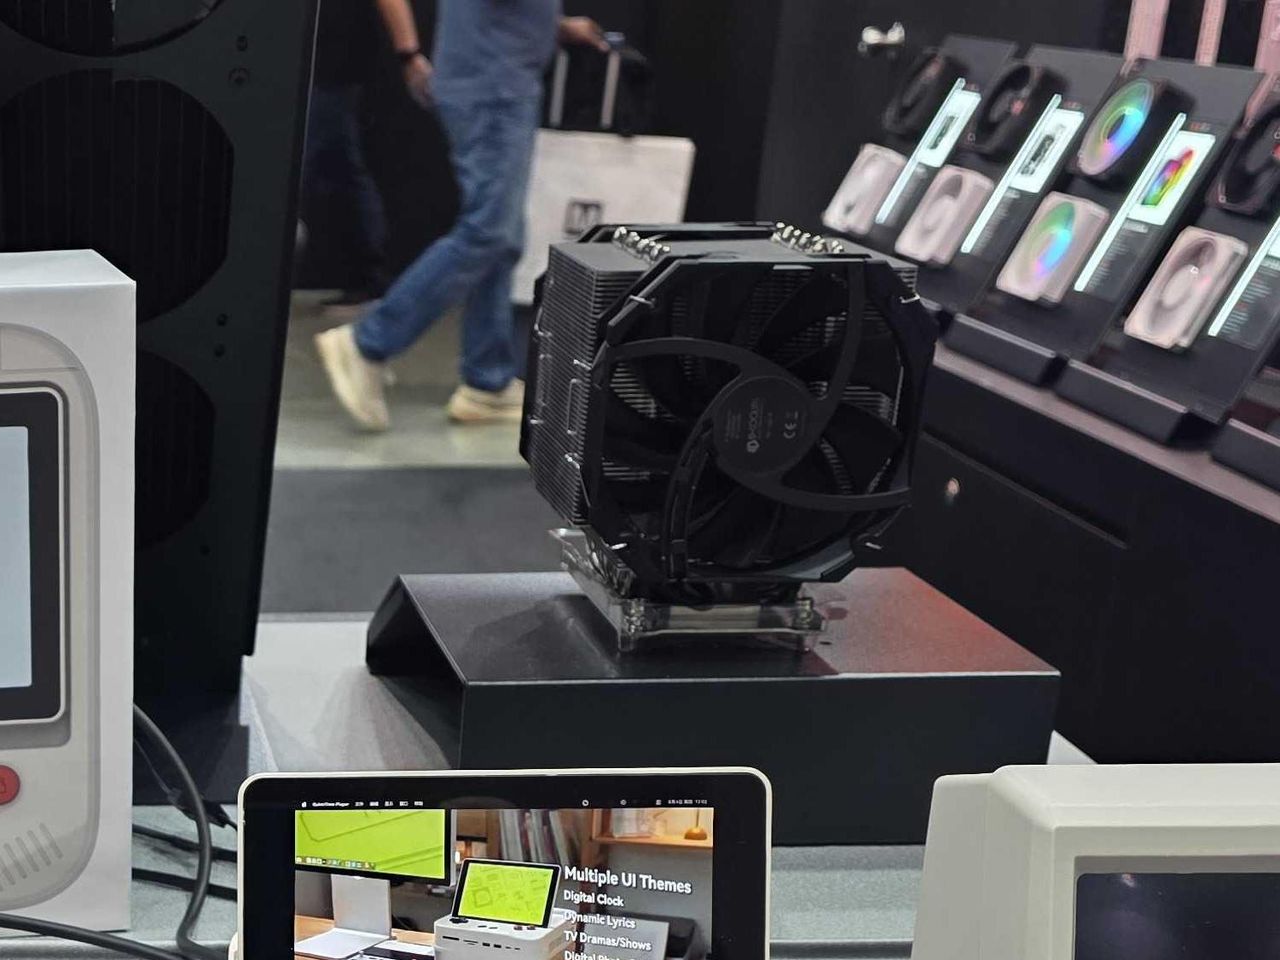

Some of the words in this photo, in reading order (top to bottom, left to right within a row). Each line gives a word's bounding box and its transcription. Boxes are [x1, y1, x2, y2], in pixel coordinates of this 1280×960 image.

[564, 866, 618, 888] Multiple
[621, 872, 636, 888] UI
[640, 874, 692, 894] Themes
[564, 890, 595, 904] Digital
[597, 894, 624, 907] Clock
[564, 912, 606, 924] Dynamic
[607, 916, 636, 930] Lyrics
[564, 930, 578, 941] TV
[580, 932, 652, 951] Dramas/Shows
